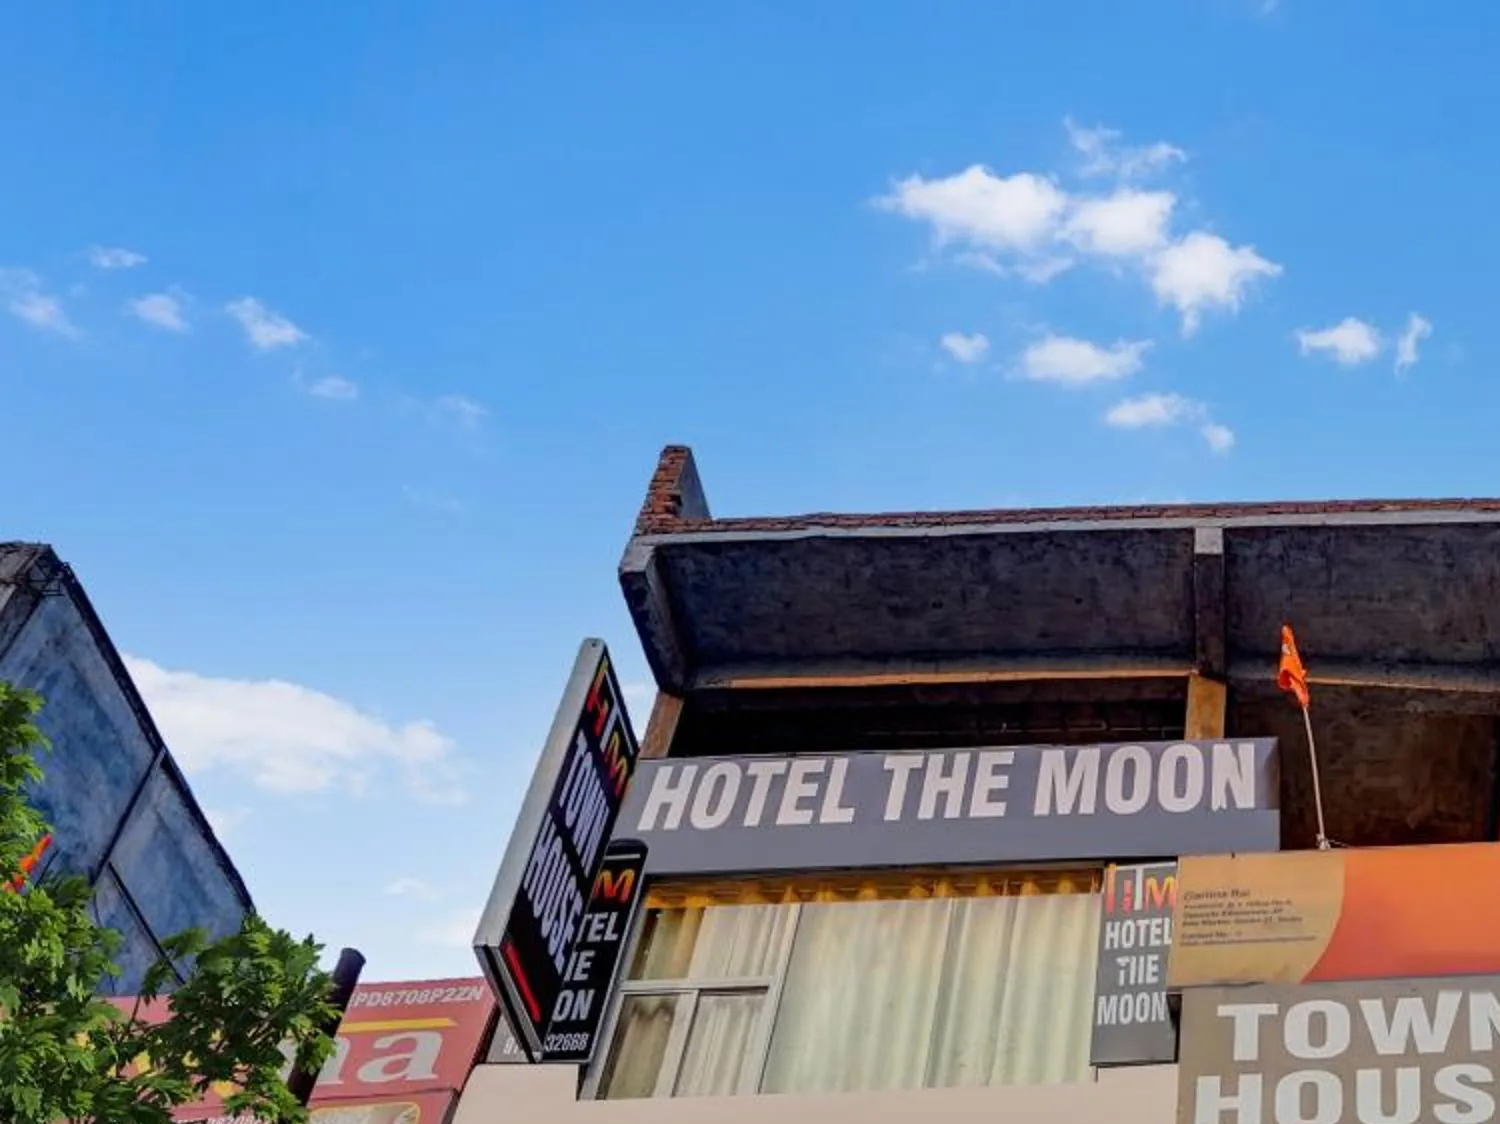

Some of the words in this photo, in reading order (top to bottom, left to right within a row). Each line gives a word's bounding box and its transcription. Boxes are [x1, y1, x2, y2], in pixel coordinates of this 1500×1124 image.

[559, 728, 611, 878] TOWN
[637, 756, 857, 832] HOTEL
[883, 749, 1014, 821] THE
[1033, 740, 1256, 817] MOON
[1105, 916, 1173, 950] HOTEL
[1116, 954, 1159, 986] THE
[1097, 991, 1168, 1026] MOON
